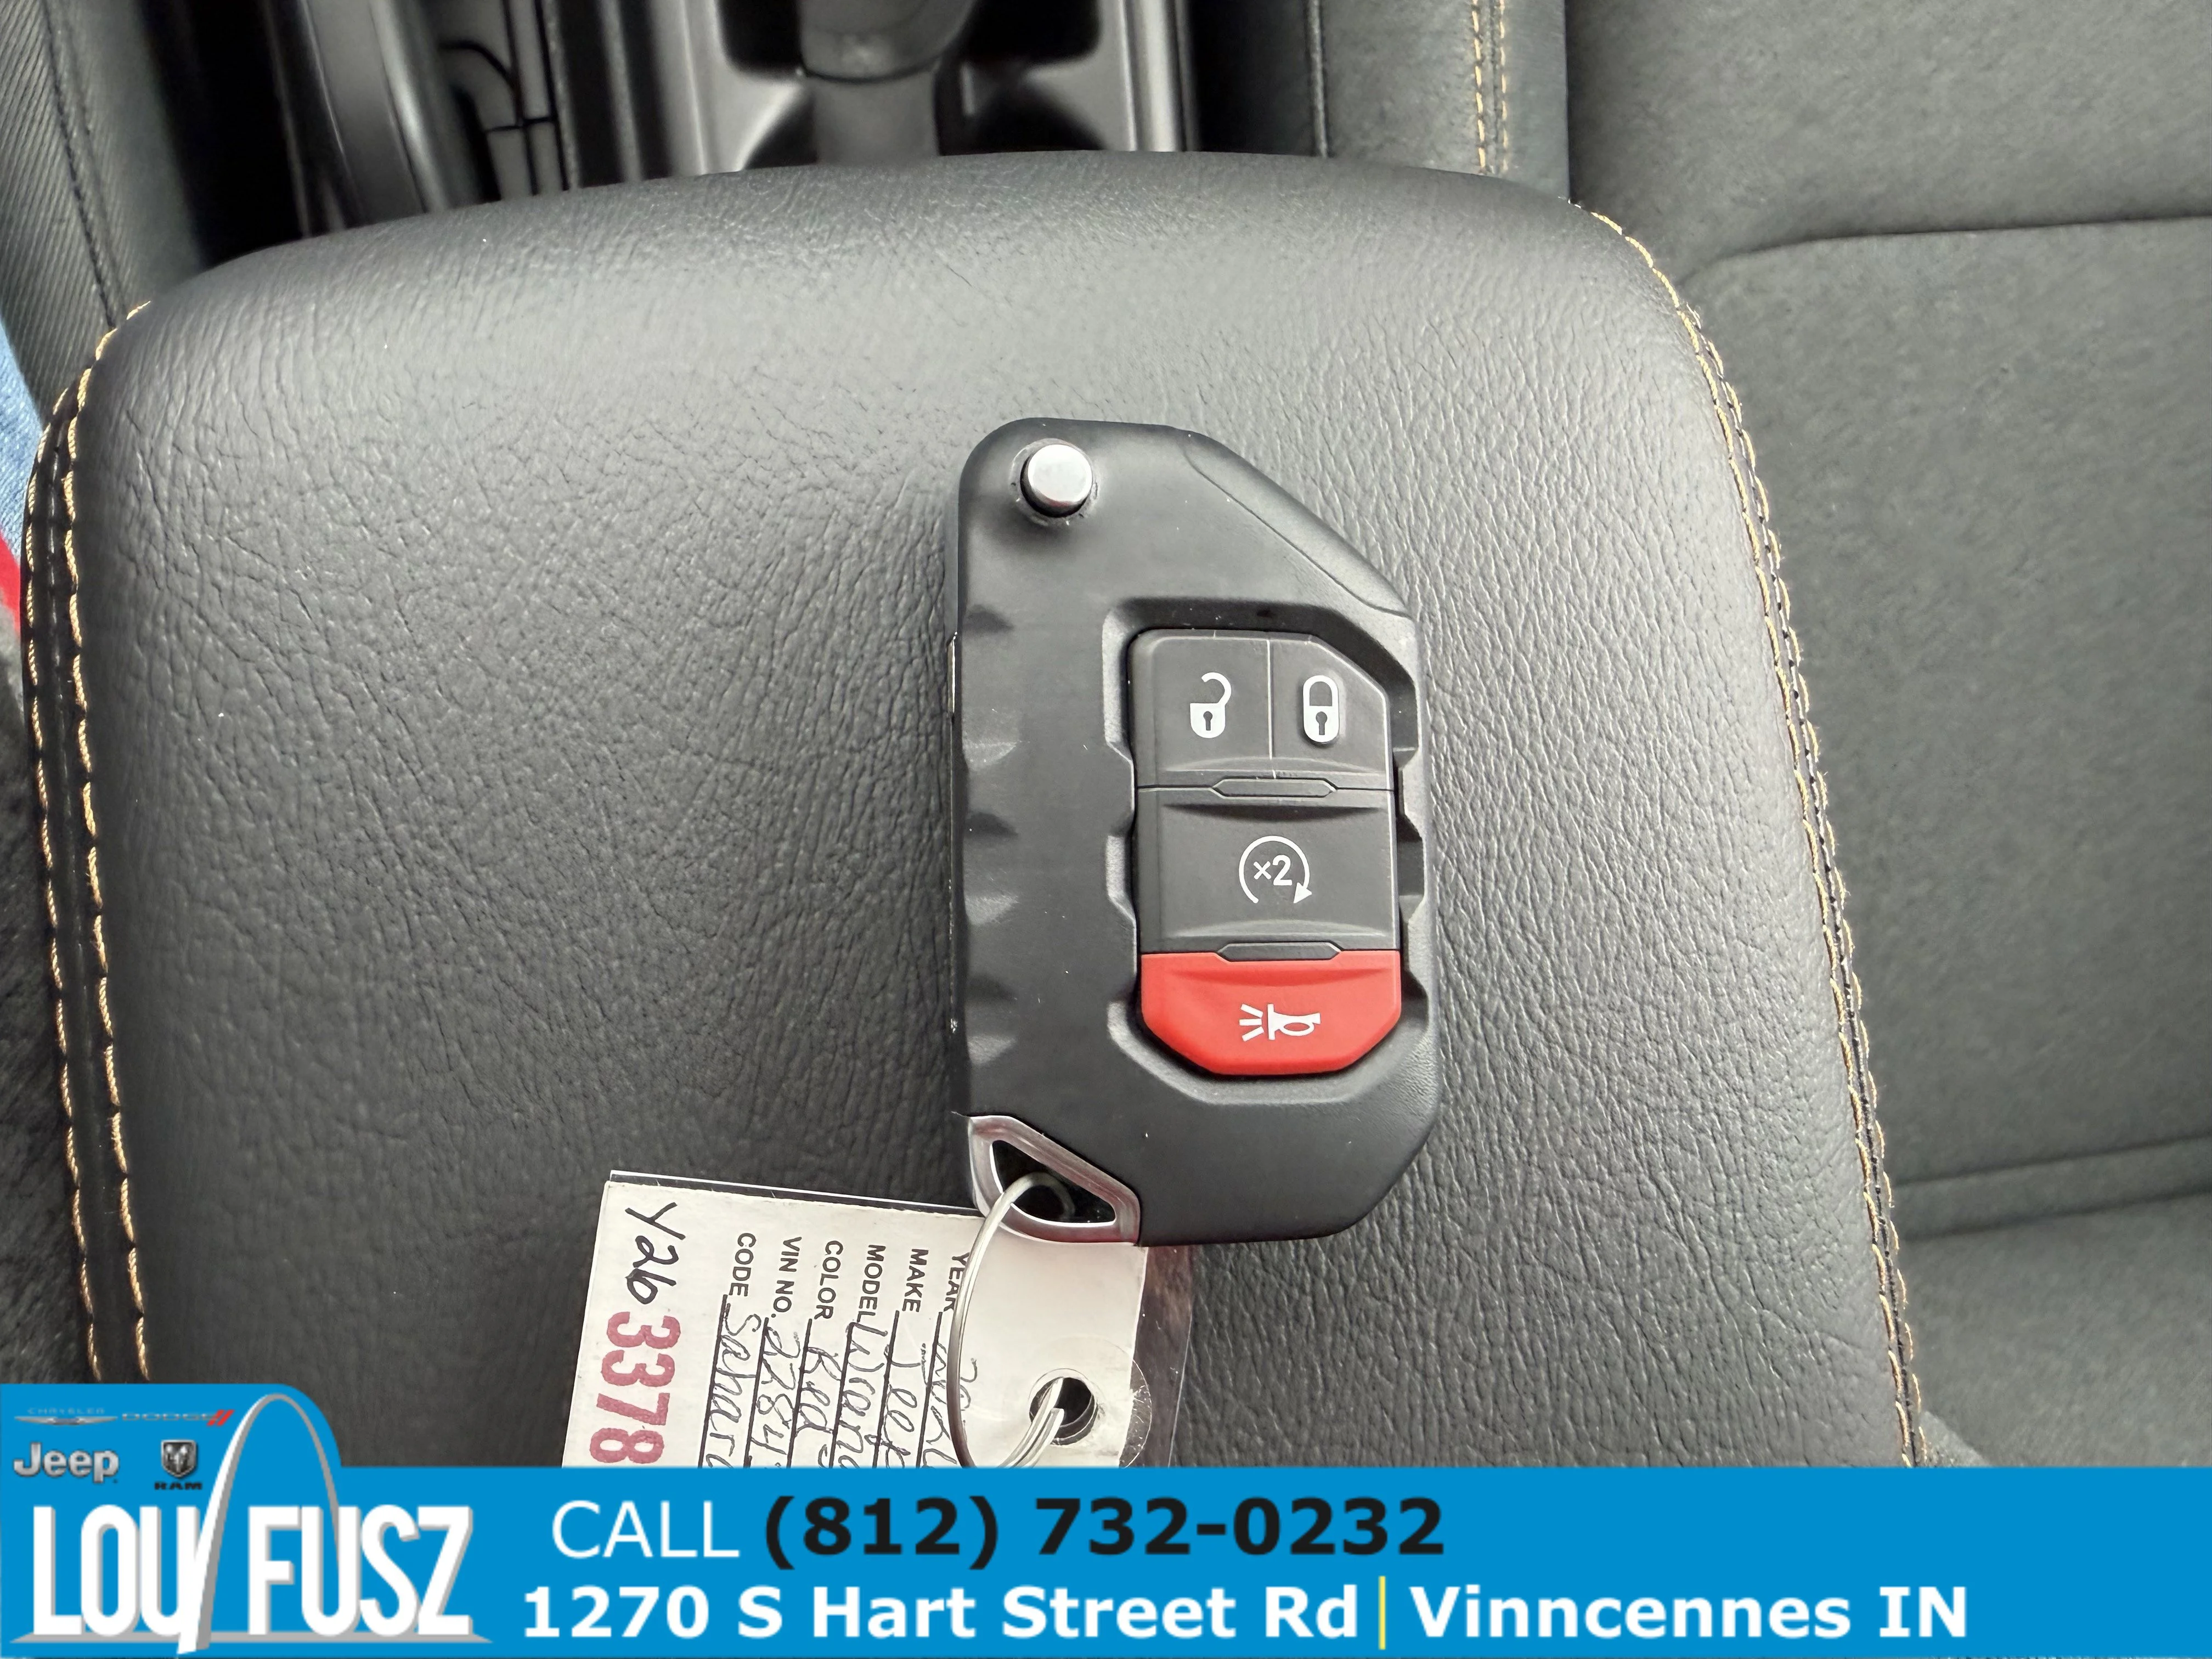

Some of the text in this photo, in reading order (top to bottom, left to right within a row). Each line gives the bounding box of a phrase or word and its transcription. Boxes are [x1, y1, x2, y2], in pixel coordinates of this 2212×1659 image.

[729, 1233, 756, 1297] CODE
[771, 1237, 802, 1318] VIN NO.
[814, 1240, 844, 1320] COLOR
[856, 1244, 886, 1323] MODEL
[901, 1249, 928, 1312] MAKE
[943, 1252, 969, 1312] YEAR
[589, 1311, 681, 1464] 3378
[748, 1327, 801, 1468] 2284
[795, 1347, 842, 1437] Red
[922, 1343, 977, 1468] 202
